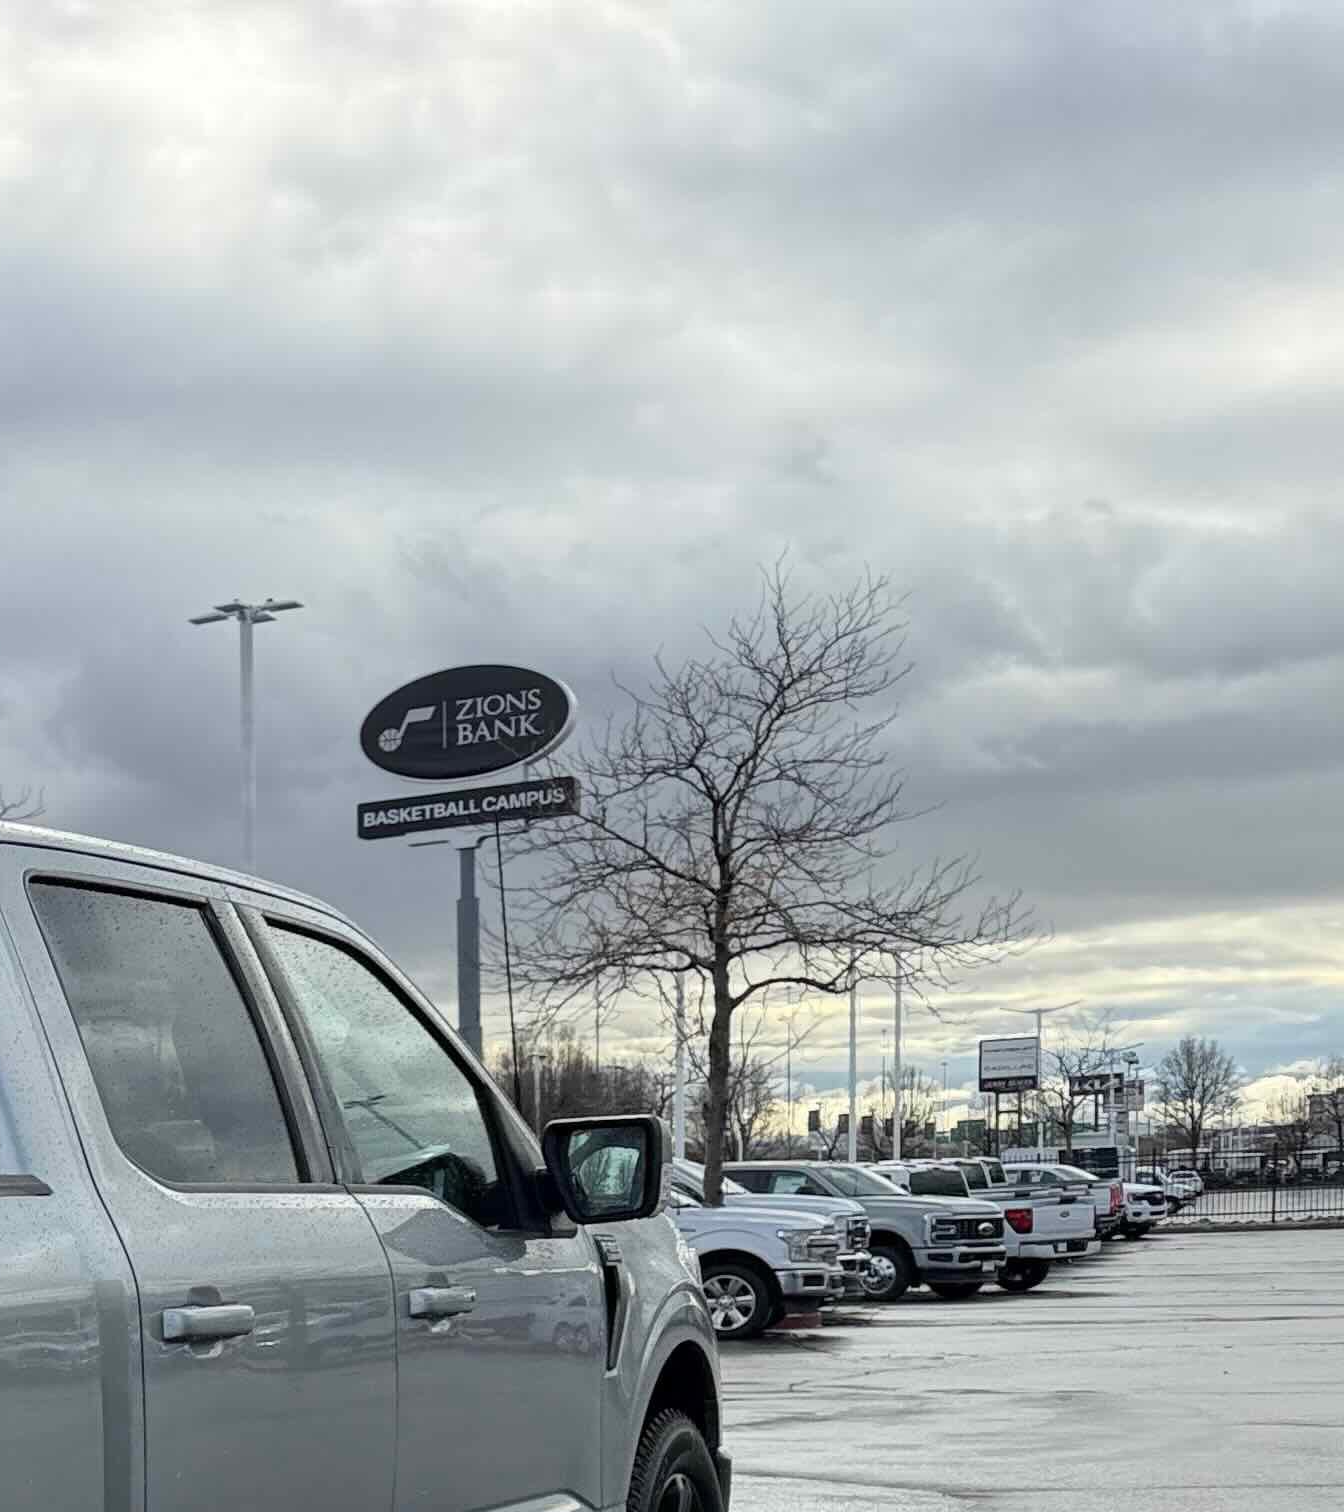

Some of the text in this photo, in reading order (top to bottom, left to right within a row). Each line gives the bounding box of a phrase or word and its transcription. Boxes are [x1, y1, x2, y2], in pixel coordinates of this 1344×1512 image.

[455, 688, 542, 721] ZIONS
[456, 713, 544, 746] BANK
[363, 787, 566, 828] BASKETBALL CAMPUS
